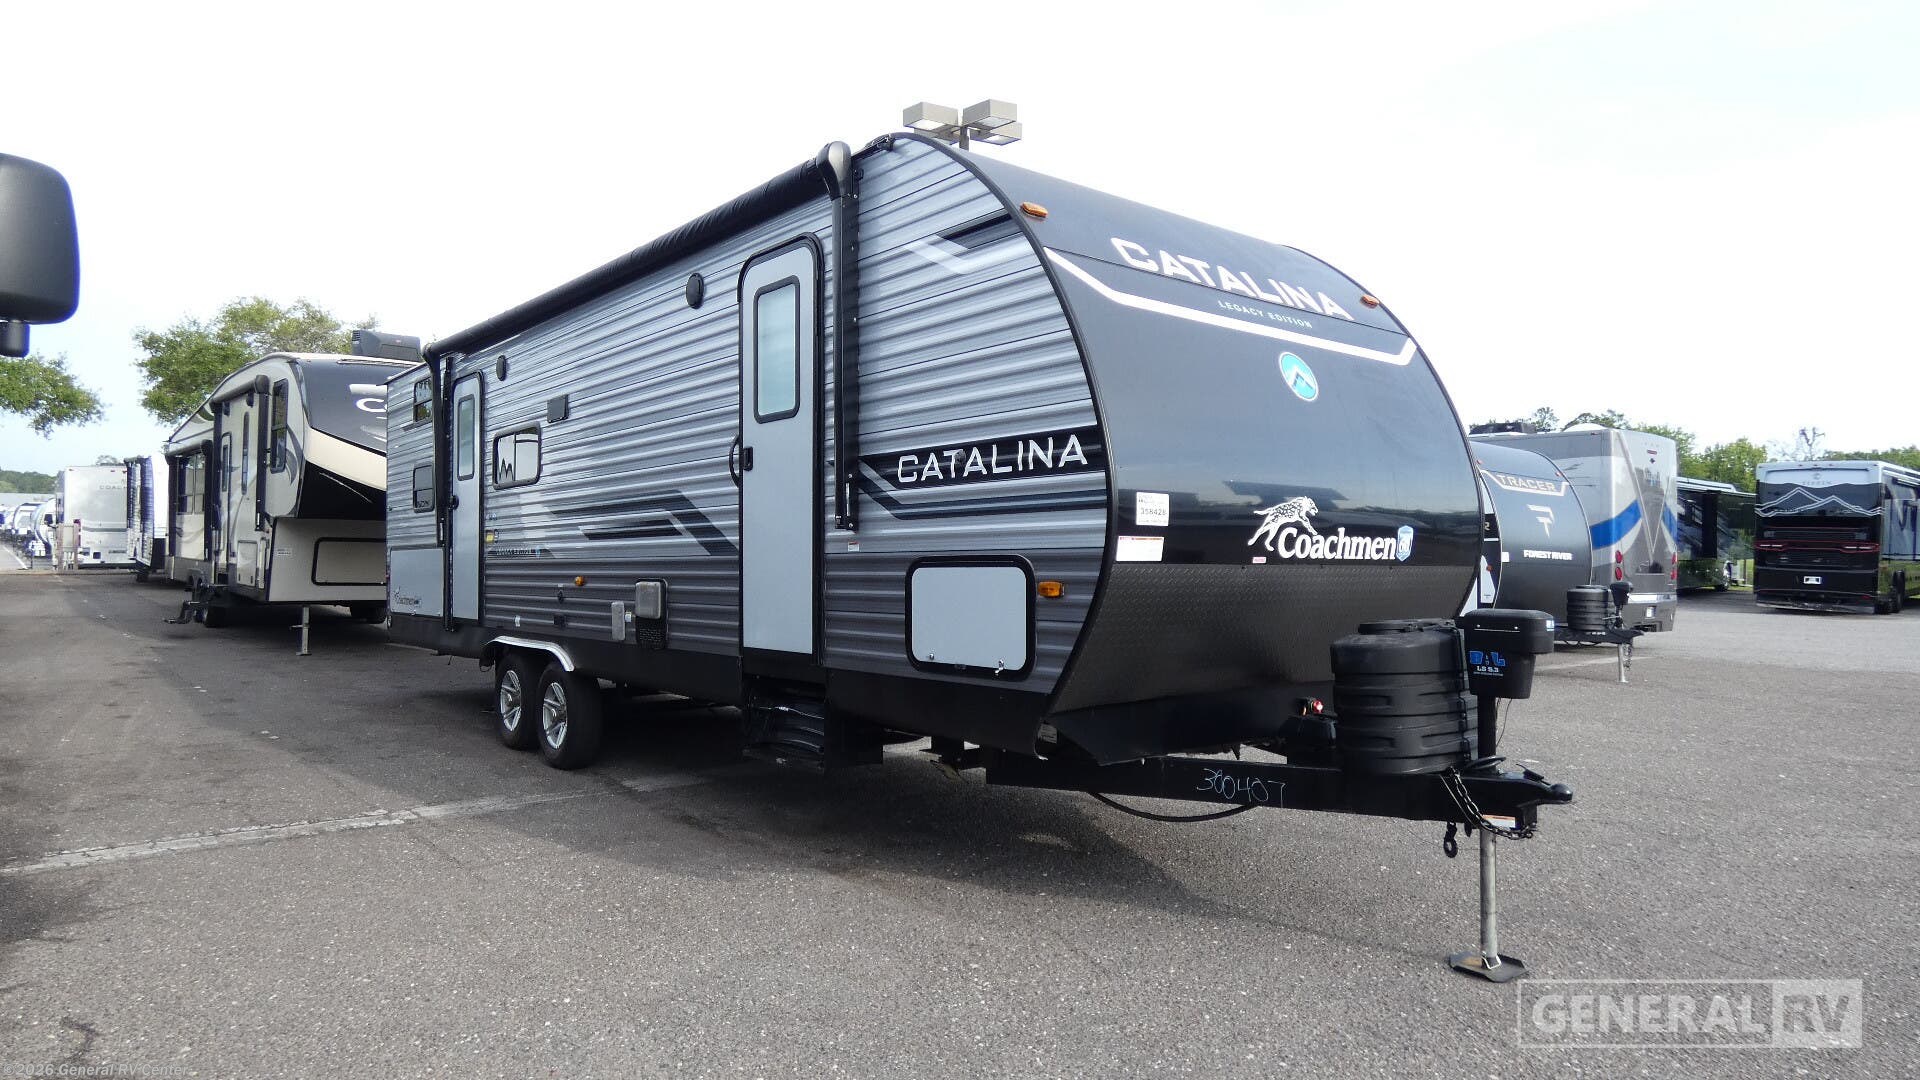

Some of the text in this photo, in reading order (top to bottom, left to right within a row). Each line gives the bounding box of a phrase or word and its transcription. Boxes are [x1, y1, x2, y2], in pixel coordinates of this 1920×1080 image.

[1110, 237, 1354, 321] CATALINA
[1217, 300, 1313, 329] LEGACY EDITION
[898, 434, 1088, 483] CATALINA
[1496, 474, 1558, 491] TRACER
[1278, 527, 1397, 561] Coachmen
[1523, 549, 1573, 561] FOREST RIVER
